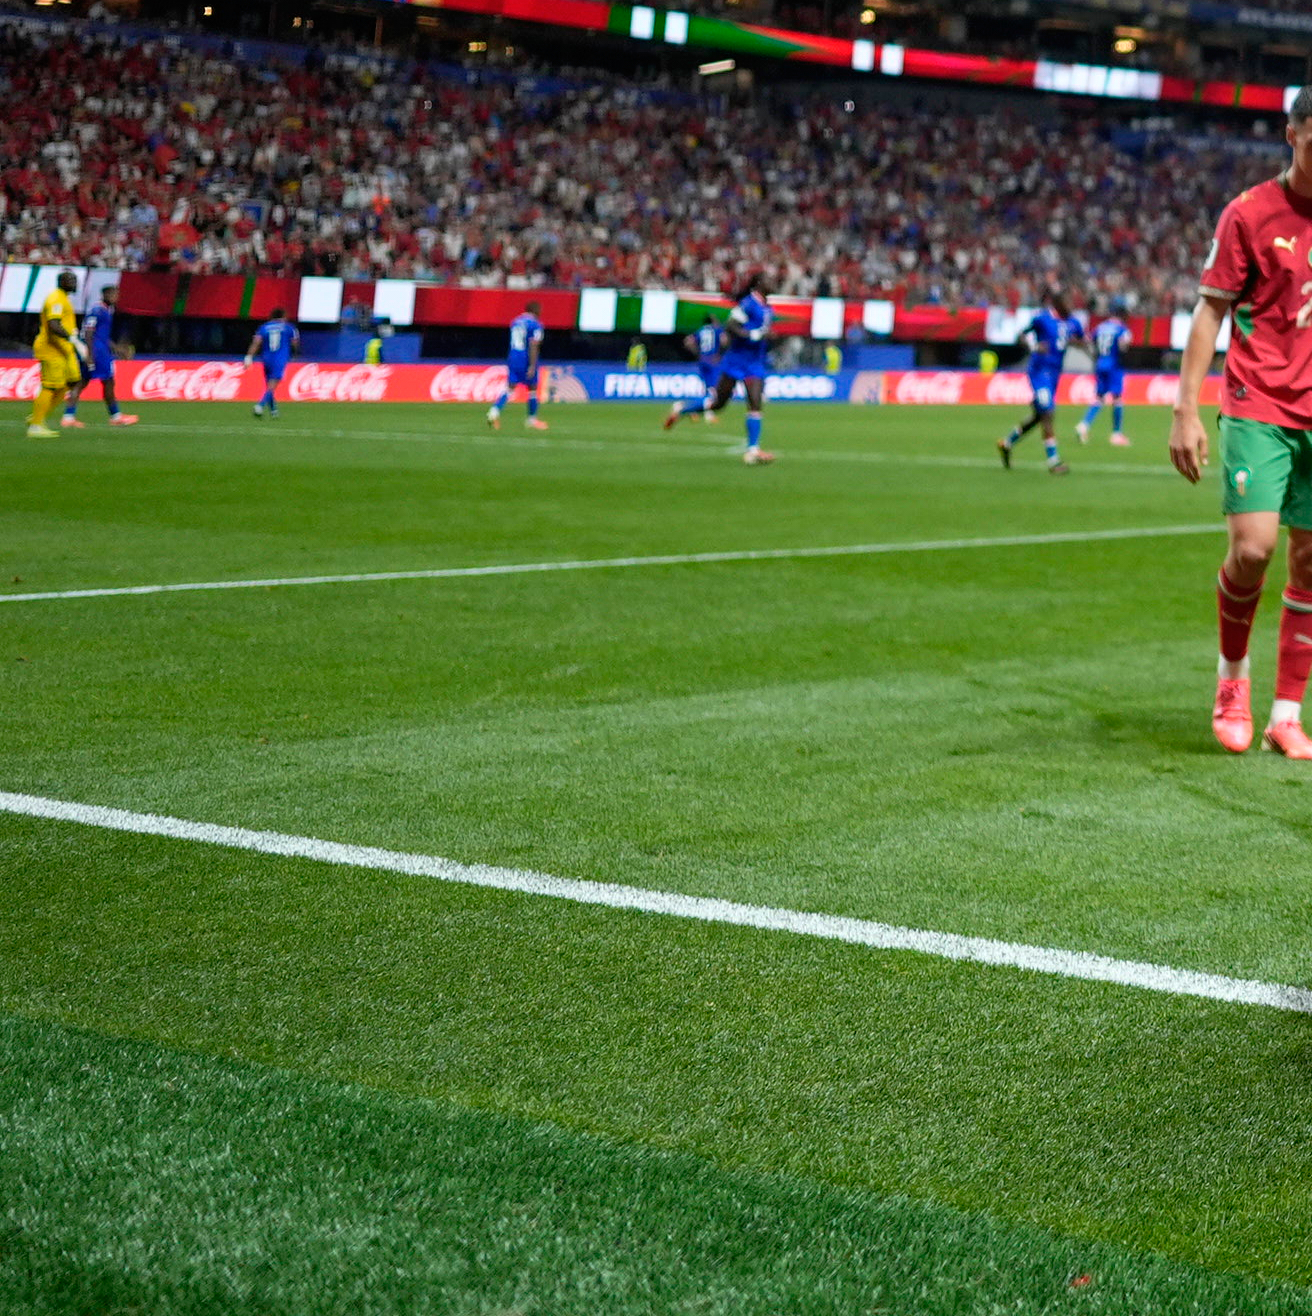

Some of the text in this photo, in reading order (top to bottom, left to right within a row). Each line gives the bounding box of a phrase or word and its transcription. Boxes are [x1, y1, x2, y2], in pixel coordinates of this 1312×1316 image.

[132, 360, 247, 401] Coca-Cola
[288, 363, 394, 402] Coca-Cola
[604, 373, 650, 398] FIFA
[763, 375, 838, 399] 2026
